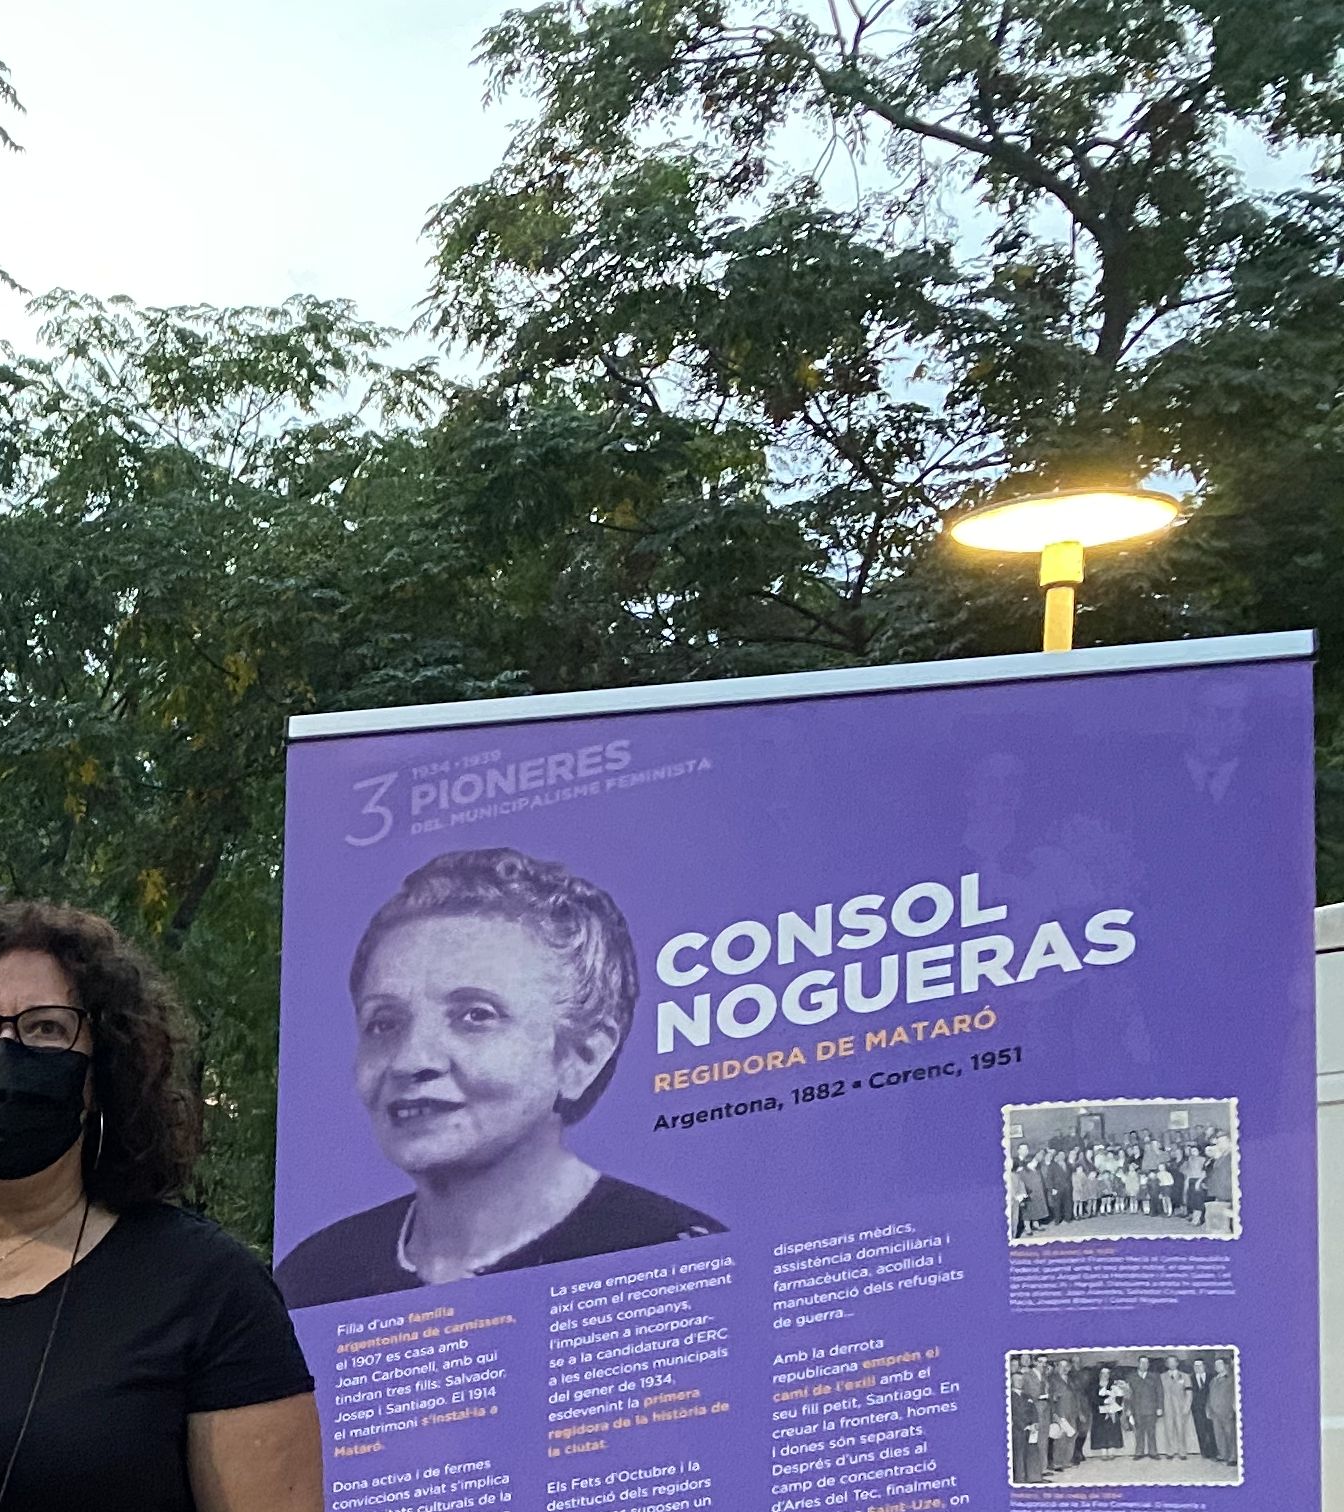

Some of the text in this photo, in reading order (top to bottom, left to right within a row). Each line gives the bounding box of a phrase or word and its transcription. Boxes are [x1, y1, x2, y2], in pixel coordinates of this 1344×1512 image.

[410, 739, 633, 816] PIONERES
[412, 750, 502, 779] 1934 1939
[344, 771, 398, 848] 3
[410, 757, 713, 835] DEL MUNICIPALISME FEMINISTA
[656, 872, 1008, 988] CONSOL
[656, 908, 1137, 1055] NOGUERAS
[652, 1004, 998, 1094] REGIDORA DE MATARÓ
[651, 1046, 1024, 1133] Argentona, 1882 Corenc, 1951
[773, 1270, 963, 1310] manutenció dels refugiats
[549, 1301, 690, 1331] dels seus companys,
[336, 1338, 468, 1370] el 1907 es casa amb
[549, 1327, 727, 1367] se a la candidatura d'ERC
[335, 1375, 366, 1387] Joan
[442, 1355, 472, 1369] amb
[476, 1350, 496, 1363] qui
[548, 1373, 675, 1403] del gener de 1934,
[771, 1459, 936, 1494] camp de concentració
